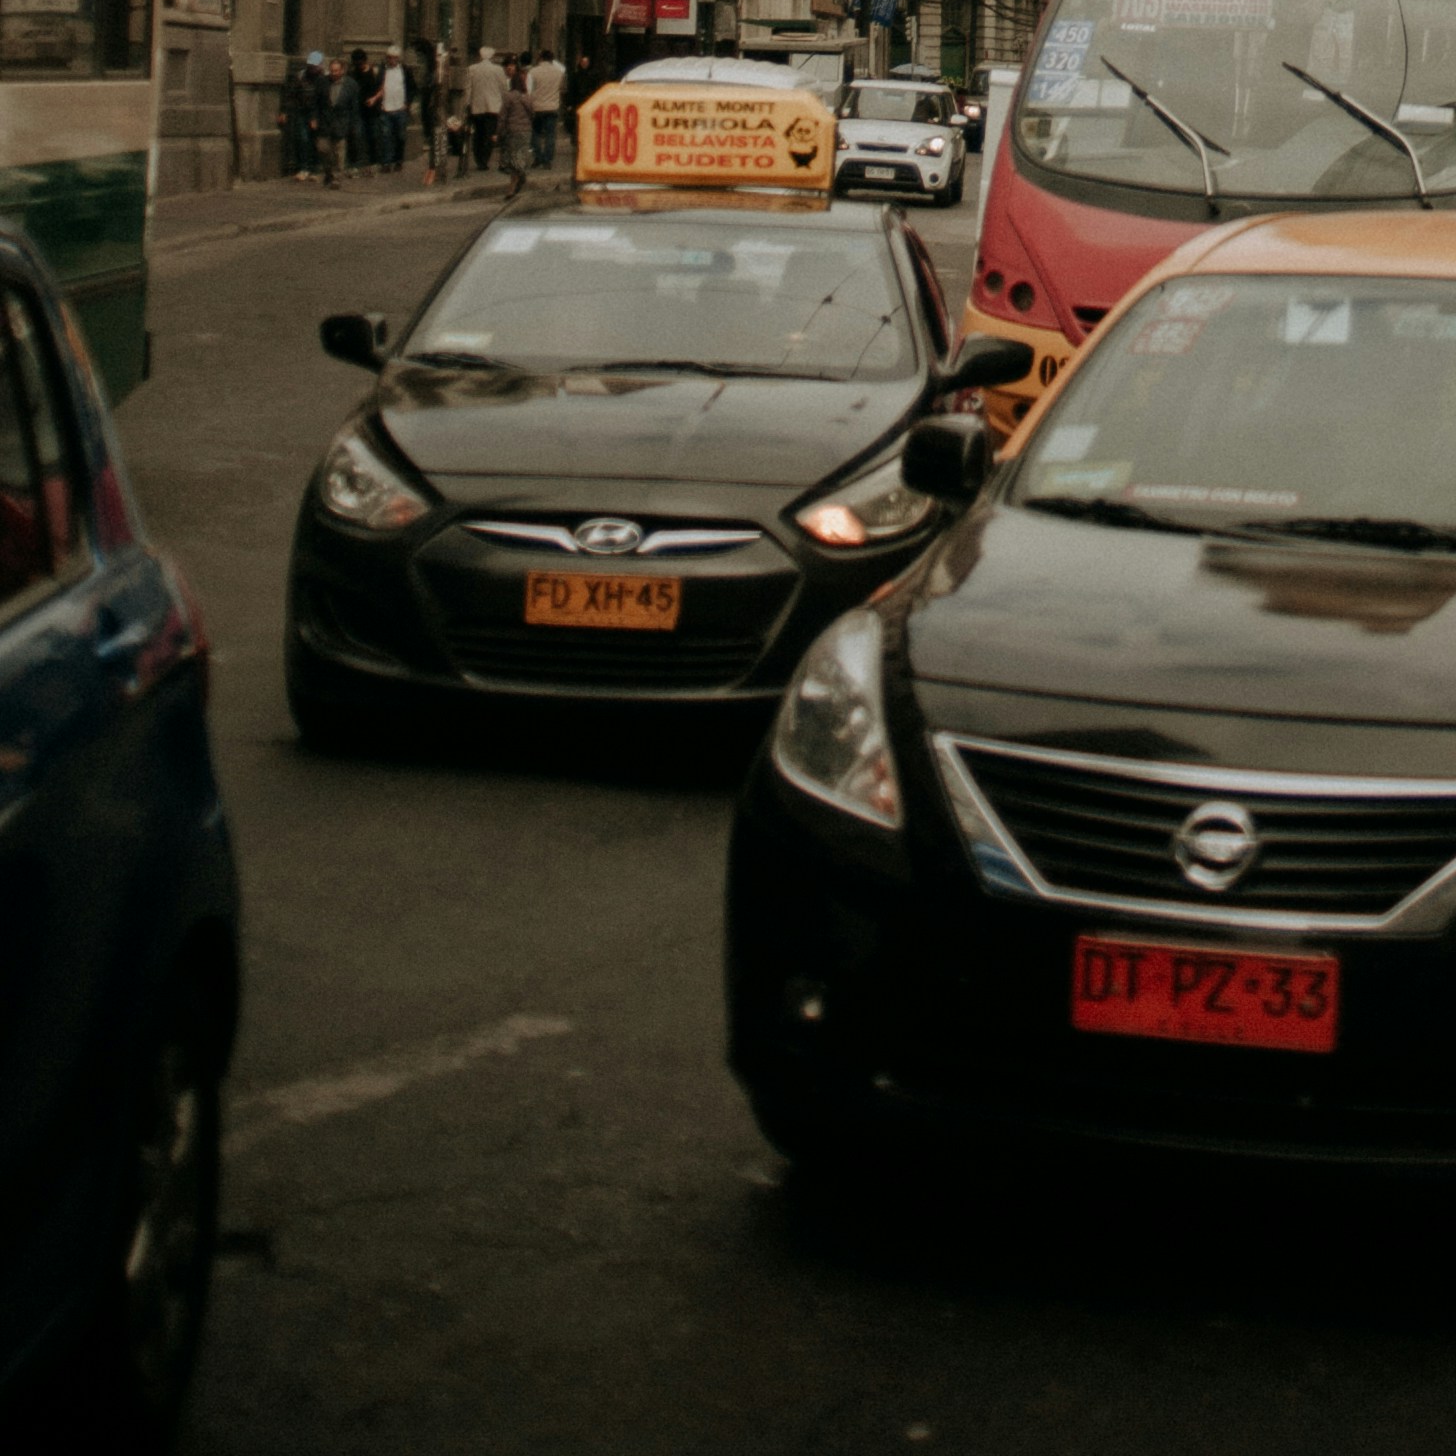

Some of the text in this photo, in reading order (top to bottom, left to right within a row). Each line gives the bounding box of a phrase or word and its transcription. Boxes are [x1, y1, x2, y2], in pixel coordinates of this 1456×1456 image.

[652, 99, 776, 115] ALMTE MONTT
[652, 116, 776, 131] URRIOLA
[591, 102, 639, 165] 168
[652, 134, 776, 149] BELLAVISTA
[655, 153, 776, 168] PUDETO
